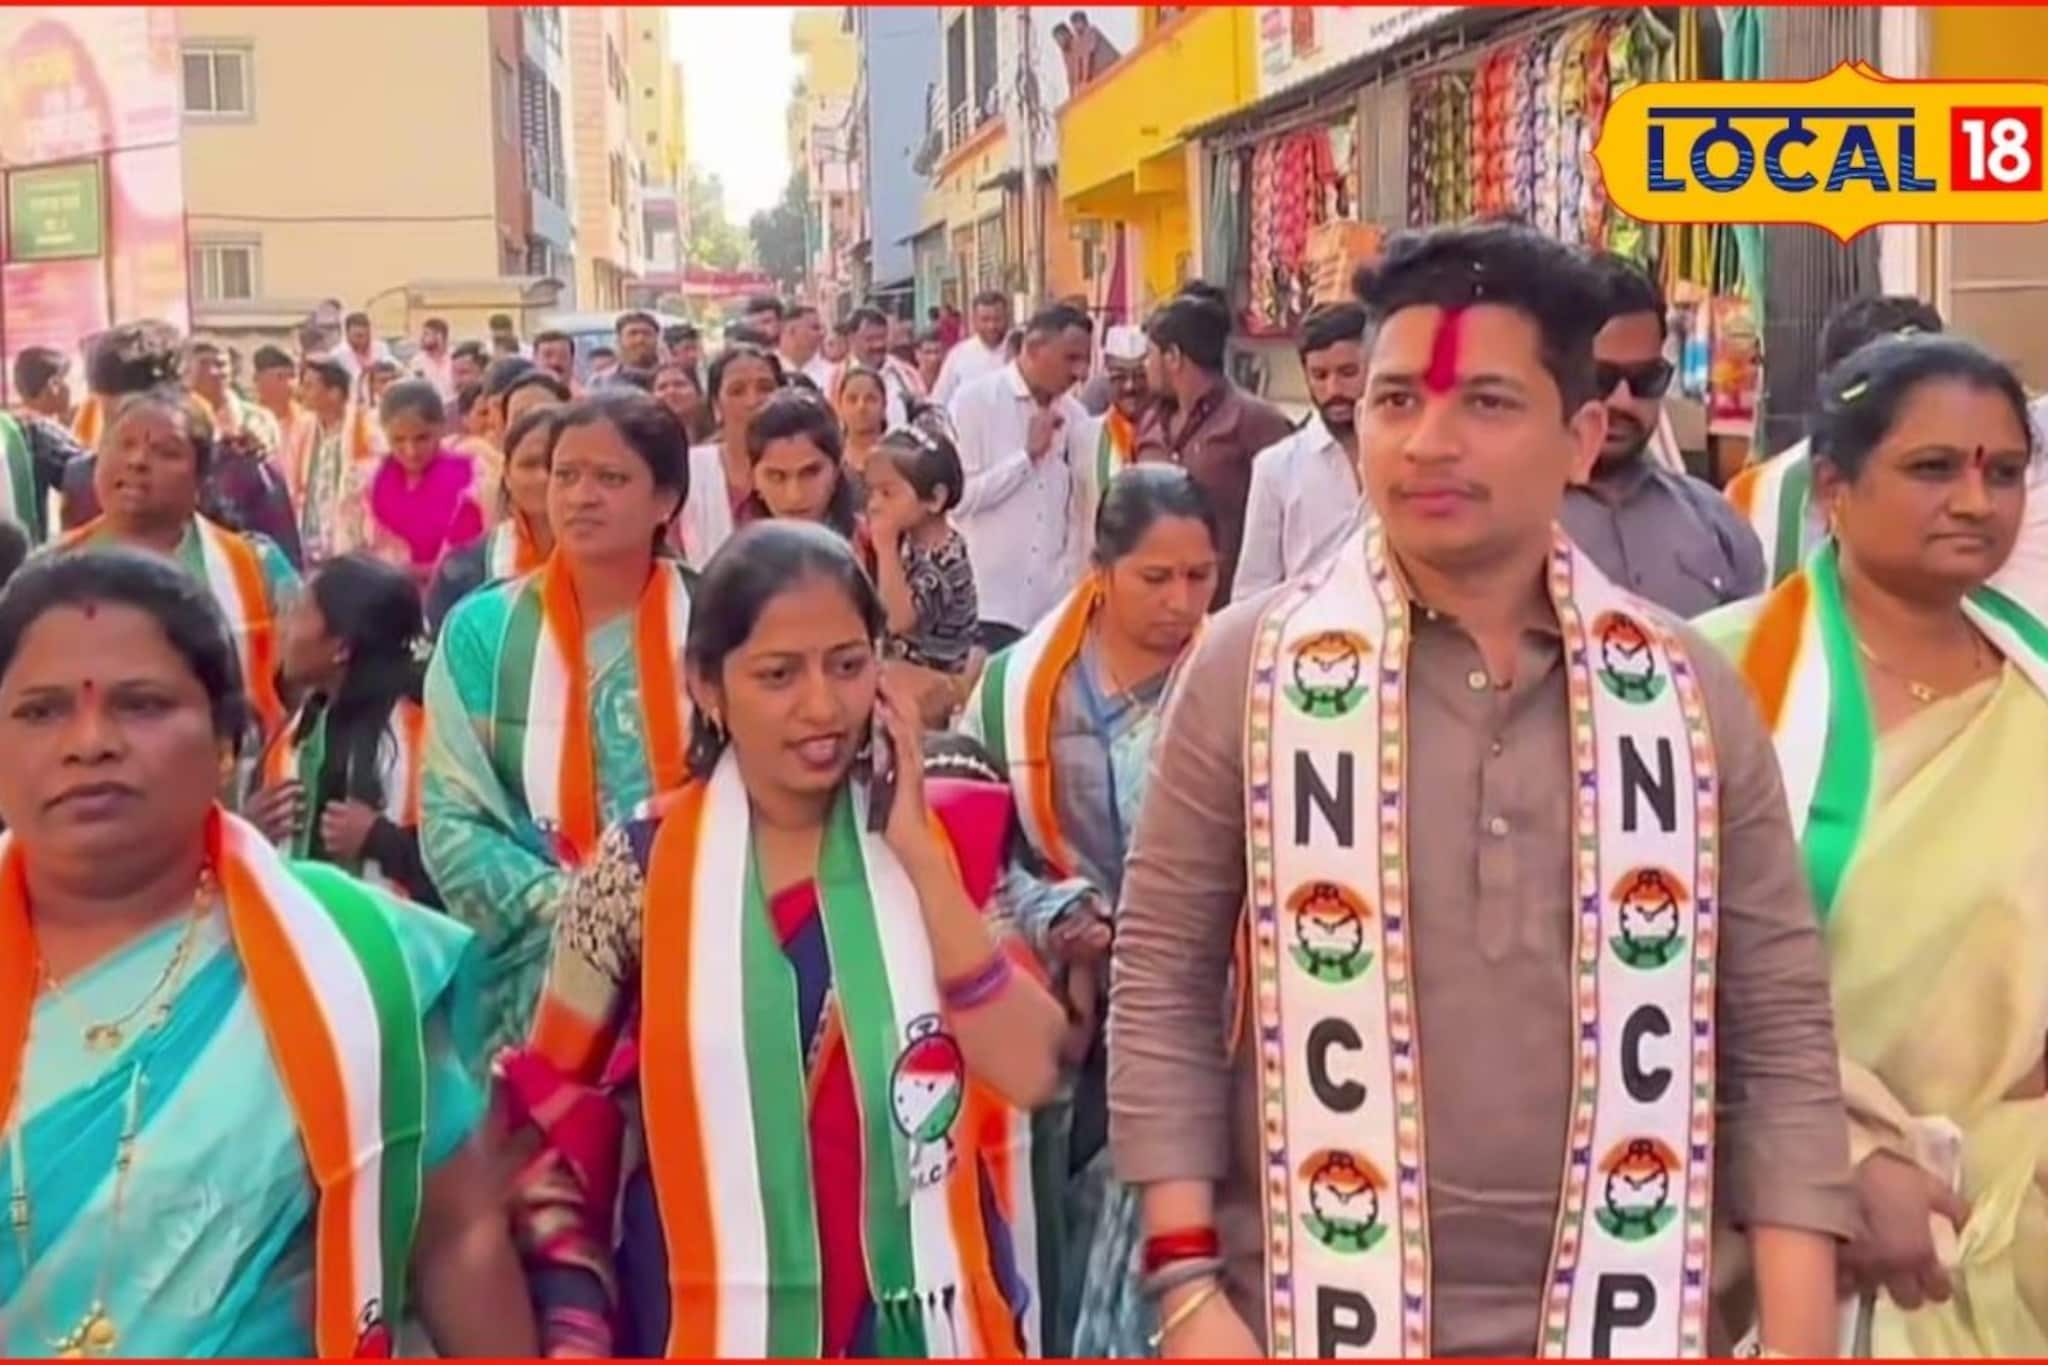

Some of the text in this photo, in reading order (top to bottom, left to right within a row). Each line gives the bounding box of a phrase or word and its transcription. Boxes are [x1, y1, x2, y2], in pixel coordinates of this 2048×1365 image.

[1295, 751, 1377, 1358] N C P
[1591, 735, 1676, 1359] N C P
